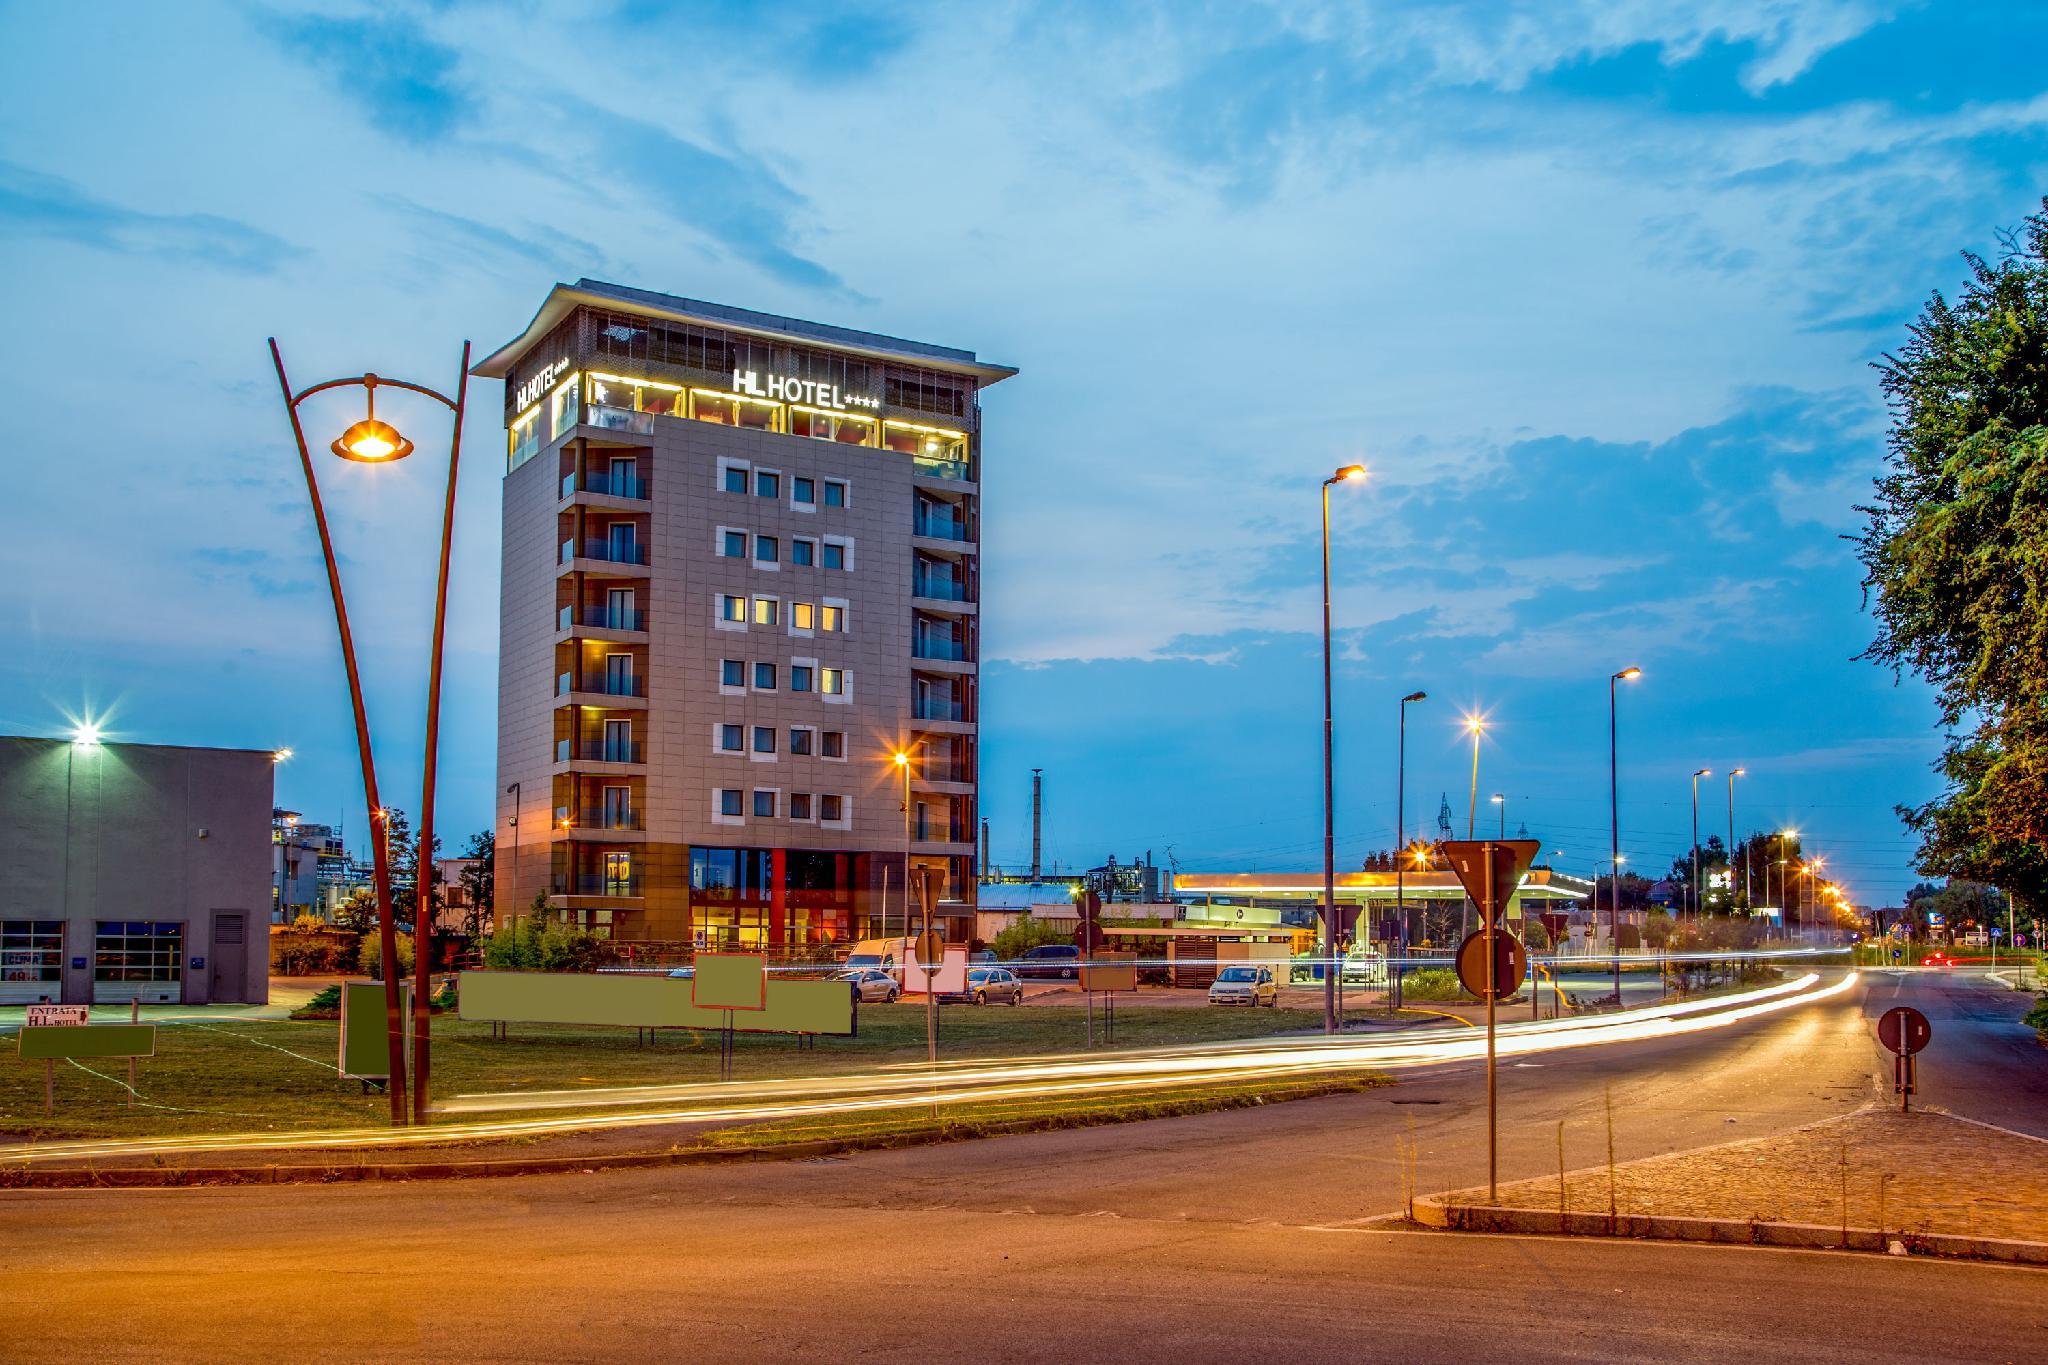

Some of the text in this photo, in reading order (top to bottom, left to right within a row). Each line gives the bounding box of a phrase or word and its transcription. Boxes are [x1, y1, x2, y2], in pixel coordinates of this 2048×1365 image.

[517, 363, 556, 413] HL HOTEL
[733, 369, 846, 409] HL HOTEL
